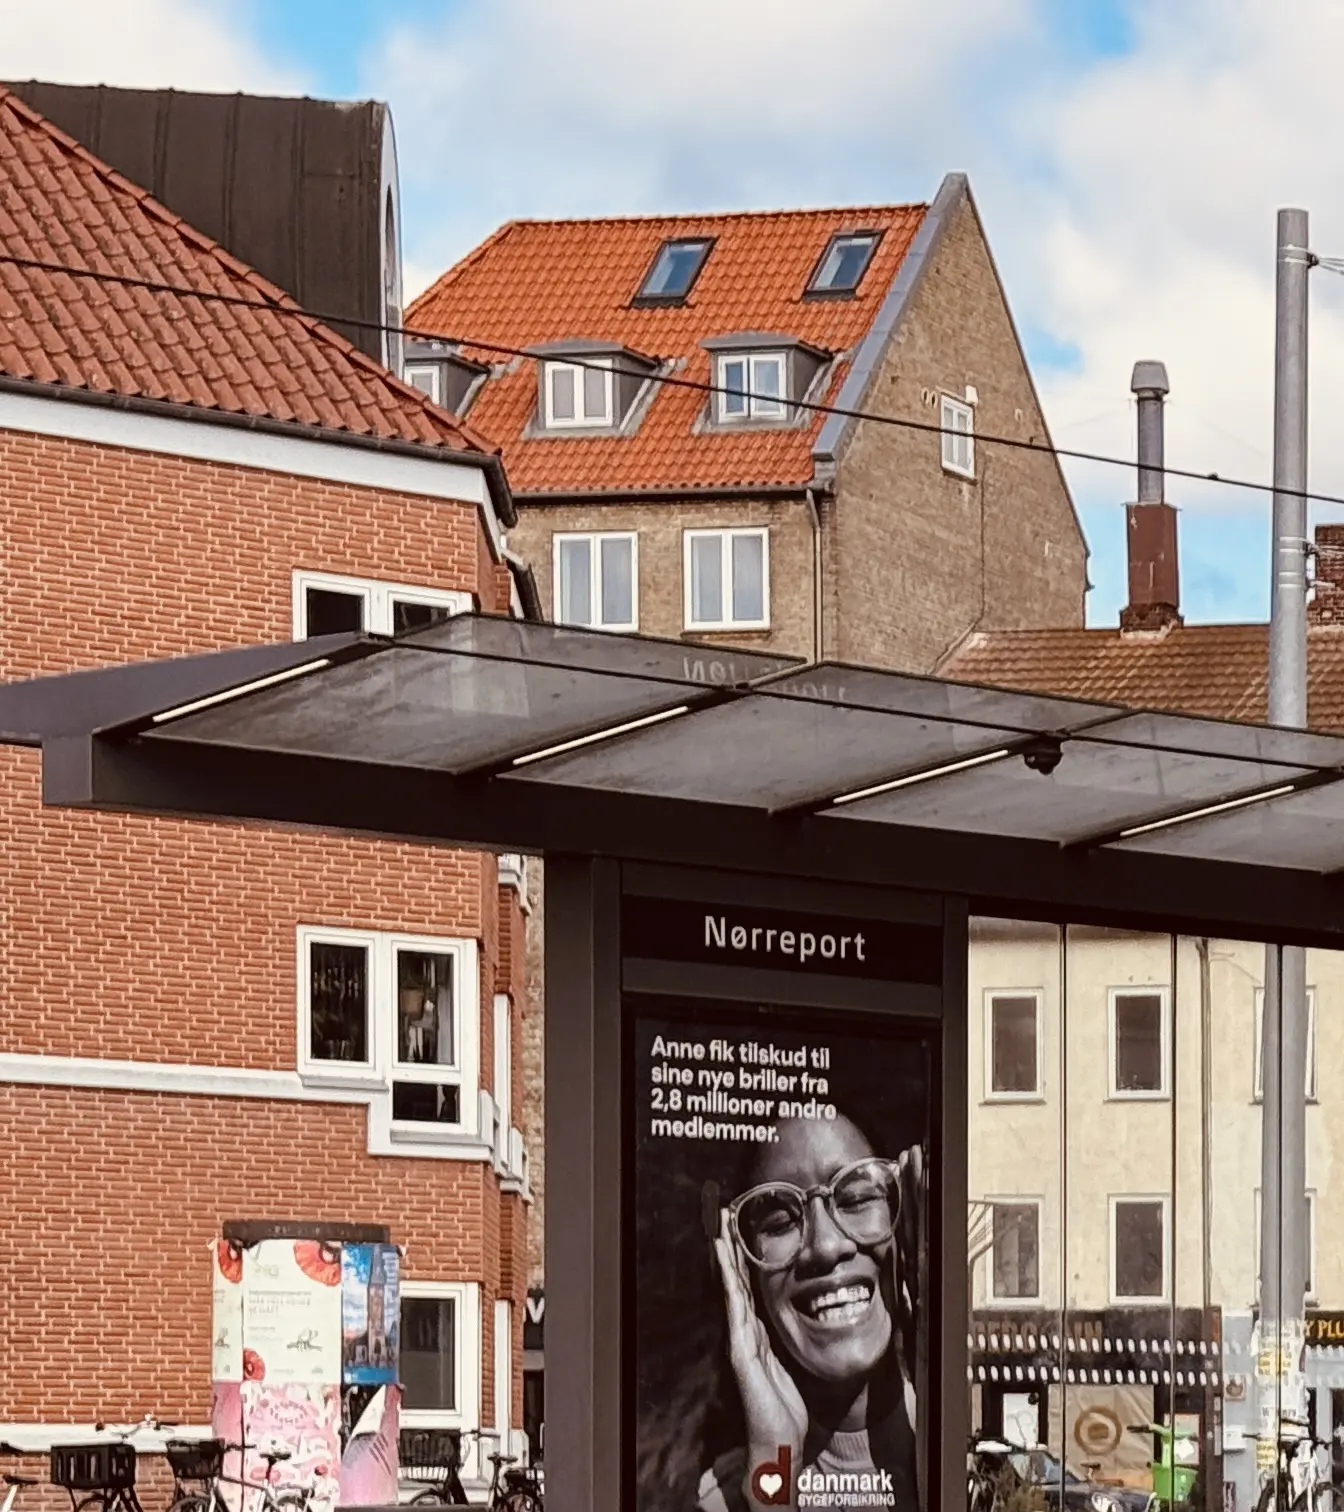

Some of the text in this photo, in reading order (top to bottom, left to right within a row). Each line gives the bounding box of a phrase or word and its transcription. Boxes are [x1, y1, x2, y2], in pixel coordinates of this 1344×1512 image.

[704, 915, 866, 963] Nørreport
[651, 1035, 831, 1070] Anne fik tilskud til
[651, 1061, 829, 1095] sine nye briller fra
[651, 1087, 837, 1120] 2,8 millioner andre
[651, 1116, 780, 1143] medlemmer.
[797, 1469, 894, 1493] danmark
